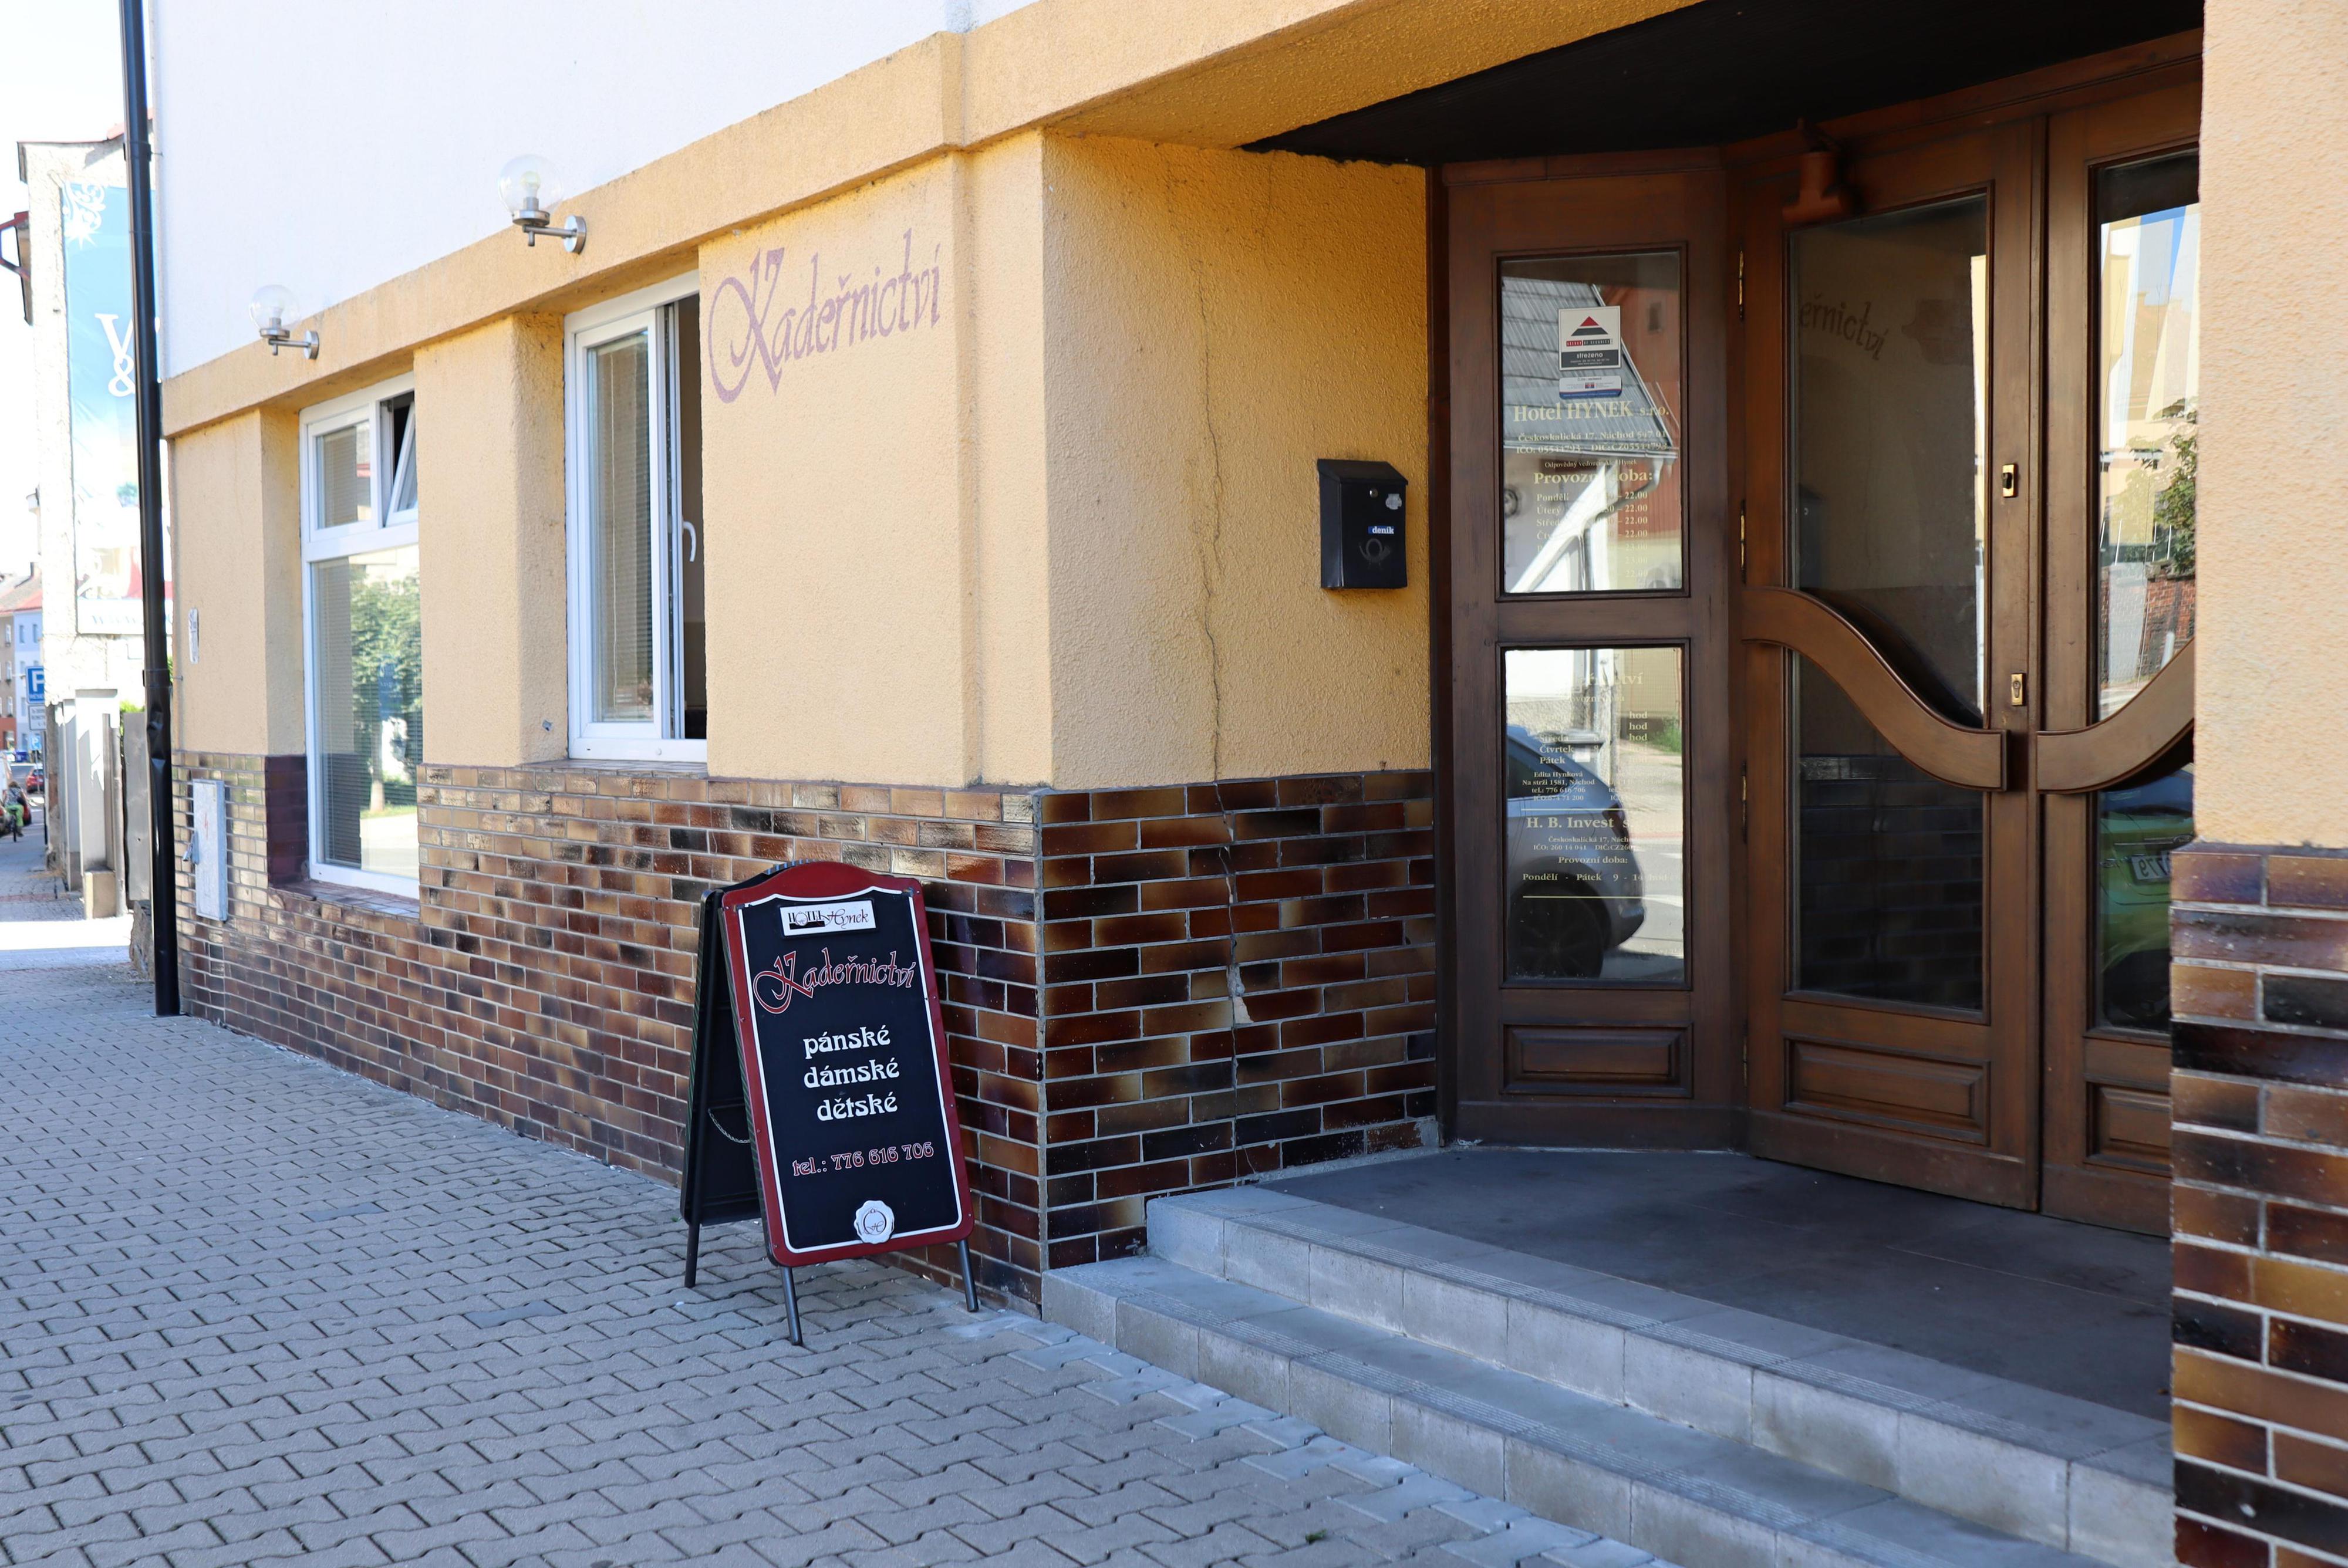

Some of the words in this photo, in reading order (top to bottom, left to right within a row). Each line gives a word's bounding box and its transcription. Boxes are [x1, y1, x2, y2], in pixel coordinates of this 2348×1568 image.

[708, 227, 941, 403] Kadeřnictví
[1513, 403, 1561, 423] Hotel
[1567, 400, 1633, 420] HYNEK
[1518, 432, 1581, 442] Českoskalická
[1600, 431, 1634, 440] Náchod
[1517, 444, 1536, 454] IČO:
[1544, 461, 1577, 469] Odpovědný
[1536, 492, 1569, 502] Pondělí
[1624, 491, 1648, 499] 22.00
[1536, 505, 1560, 516] Úterý
[1624, 504, 1648, 512] 22.00
[1624, 516, 1648, 525] 22.00
[1624, 529, 1648, 538] 22.00
[1629, 710, 1648, 719] hod
[1629, 722, 1648, 731] hod
[1629, 732, 1648, 742] hod
[1539, 745, 1574, 753] Čtvrtek
[1526, 817, 1543, 828] H.
[1548, 817, 1562, 828] B.
[1567, 817, 1614, 828] Invest
[1558, 856, 1600, 864] Provozní
[1603, 856, 1628, 864] doba:
[1523, 873, 1558, 881] Pondělí
[1577, 873, 1602, 881] Pátek
[821, 908, 869, 929] Hynek
[753, 947, 916, 1014] Kadeřnictví
[803, 1025, 890, 1059] pánské
[804, 1057, 900, 1089] dámské
[817, 1091, 898, 1121] dětské
[792, 1157, 828, 1177] tel.:
[831, 1151, 865, 1171] 776
[868, 1146, 899, 1165] 616
[902, 1141, 935, 1160] 706
